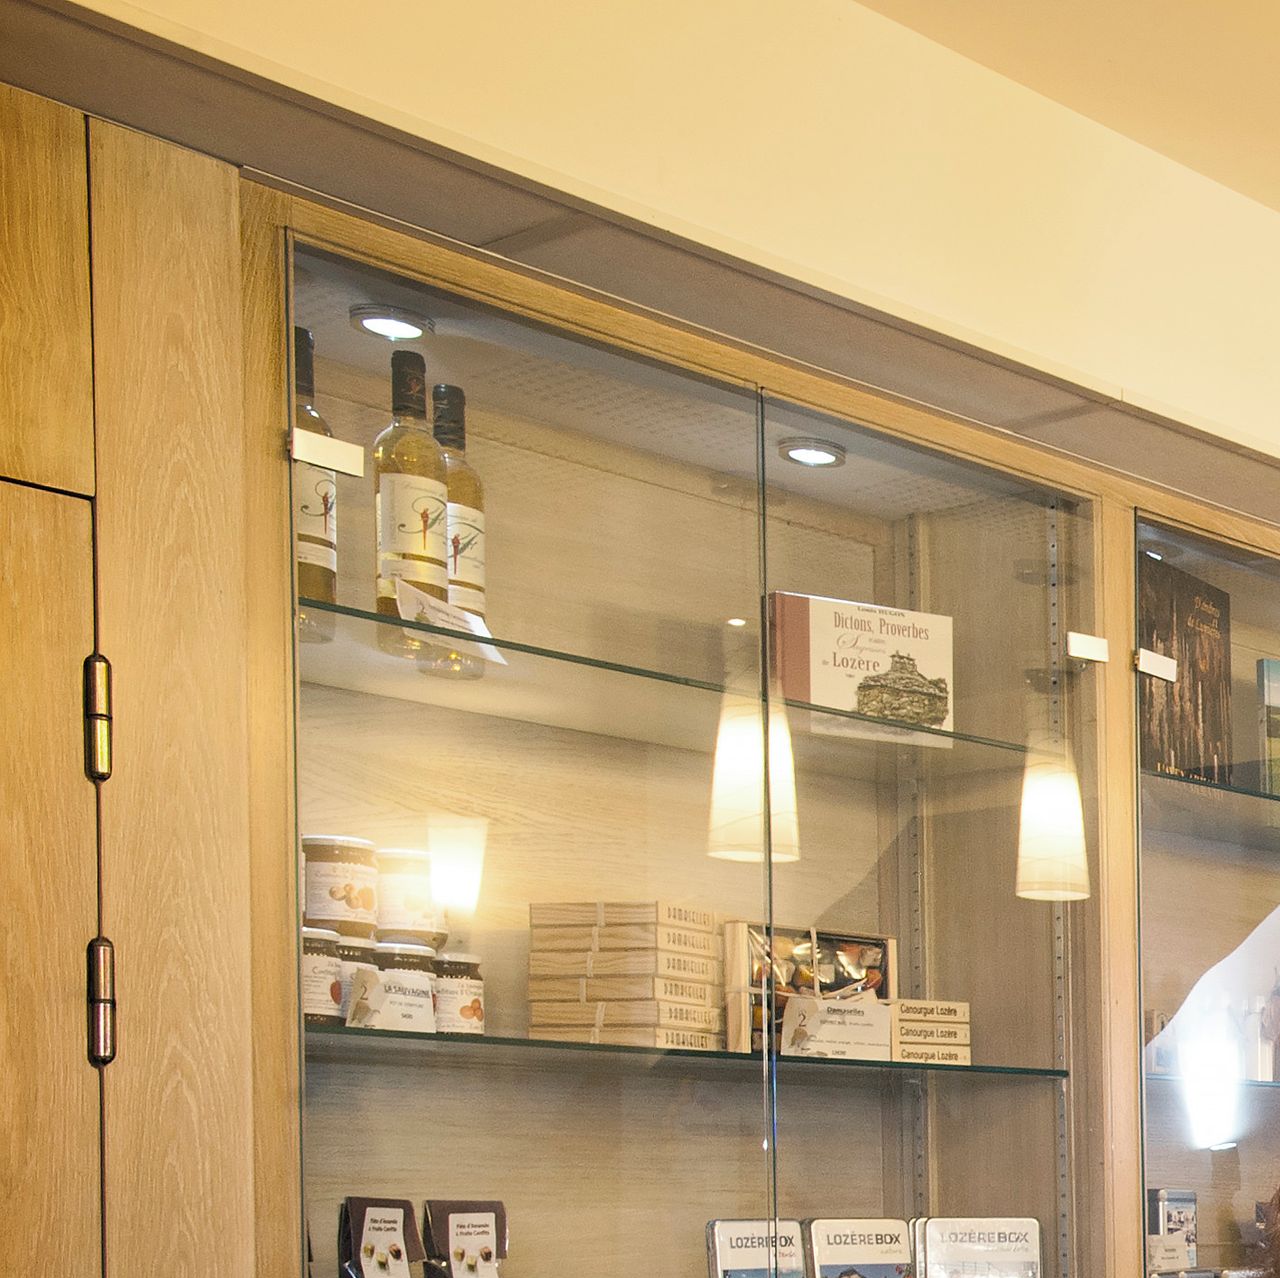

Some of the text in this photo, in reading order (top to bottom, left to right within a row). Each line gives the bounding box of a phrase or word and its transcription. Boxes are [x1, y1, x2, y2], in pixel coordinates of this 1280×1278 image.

[833, 611, 930, 641] Dictons, Proverbes
[832, 651, 881, 672] Lozère
[900, 1003, 958, 1018] Canourgue Lozère
[900, 1026, 958, 1041] Canourgue Lozère
[901, 1049, 959, 1063] Canourgue Lozère
[826, 1233, 902, 1247] LOZÈREBOX
